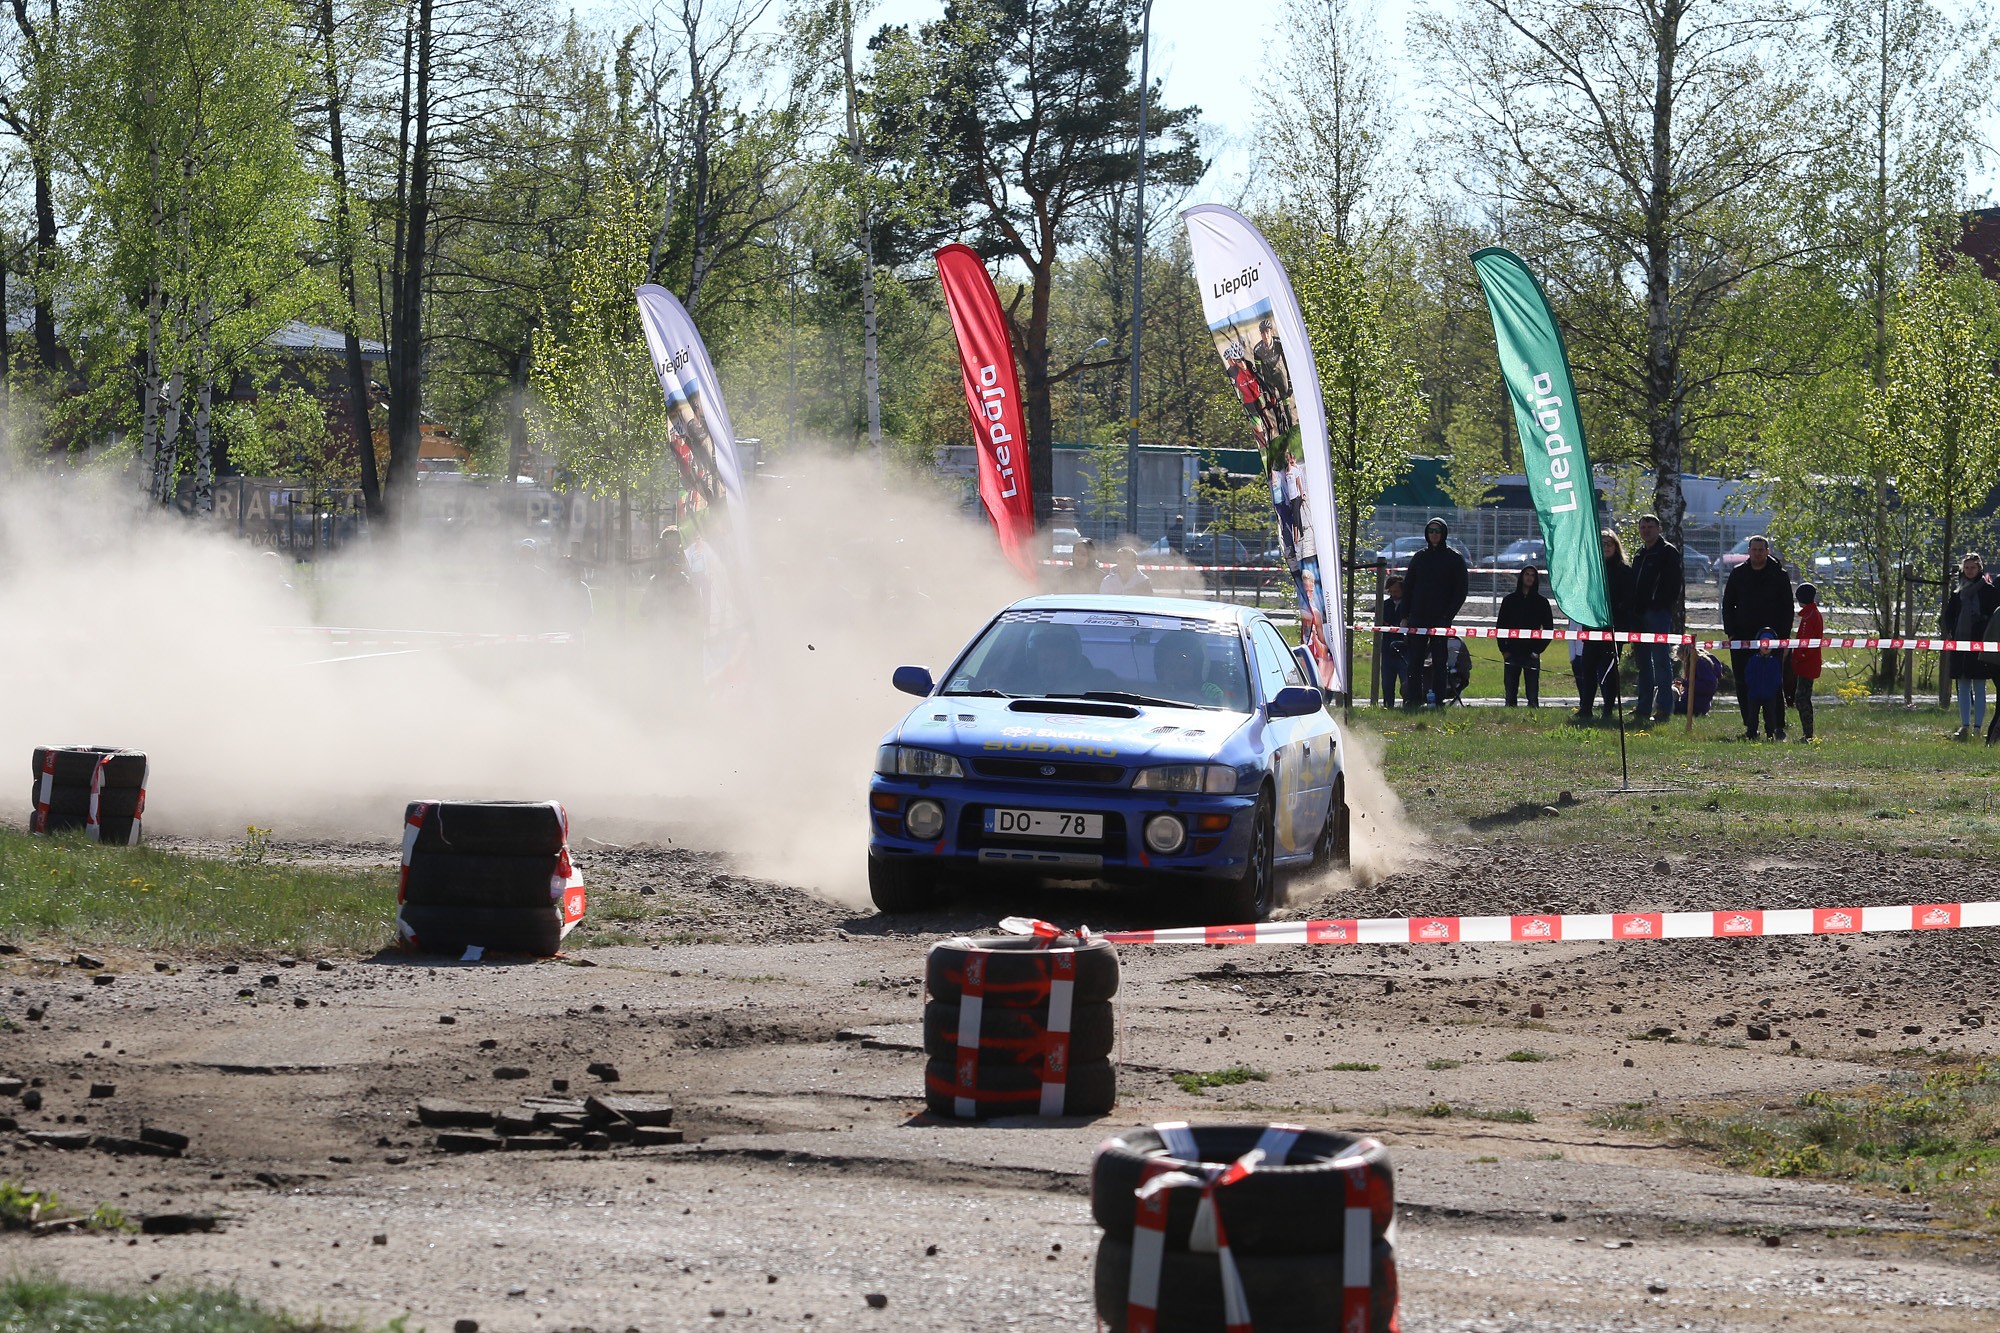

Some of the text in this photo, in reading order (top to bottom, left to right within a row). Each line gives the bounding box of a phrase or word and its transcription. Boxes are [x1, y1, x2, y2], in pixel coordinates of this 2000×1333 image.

[1213, 266, 1260, 299] Liepāja
[976, 364, 1018, 499] Liepāja
[1526, 371, 1578, 514] Liepāja
[982, 740, 1119, 759] SUBARU
[1060, 814, 1086, 836] 78
